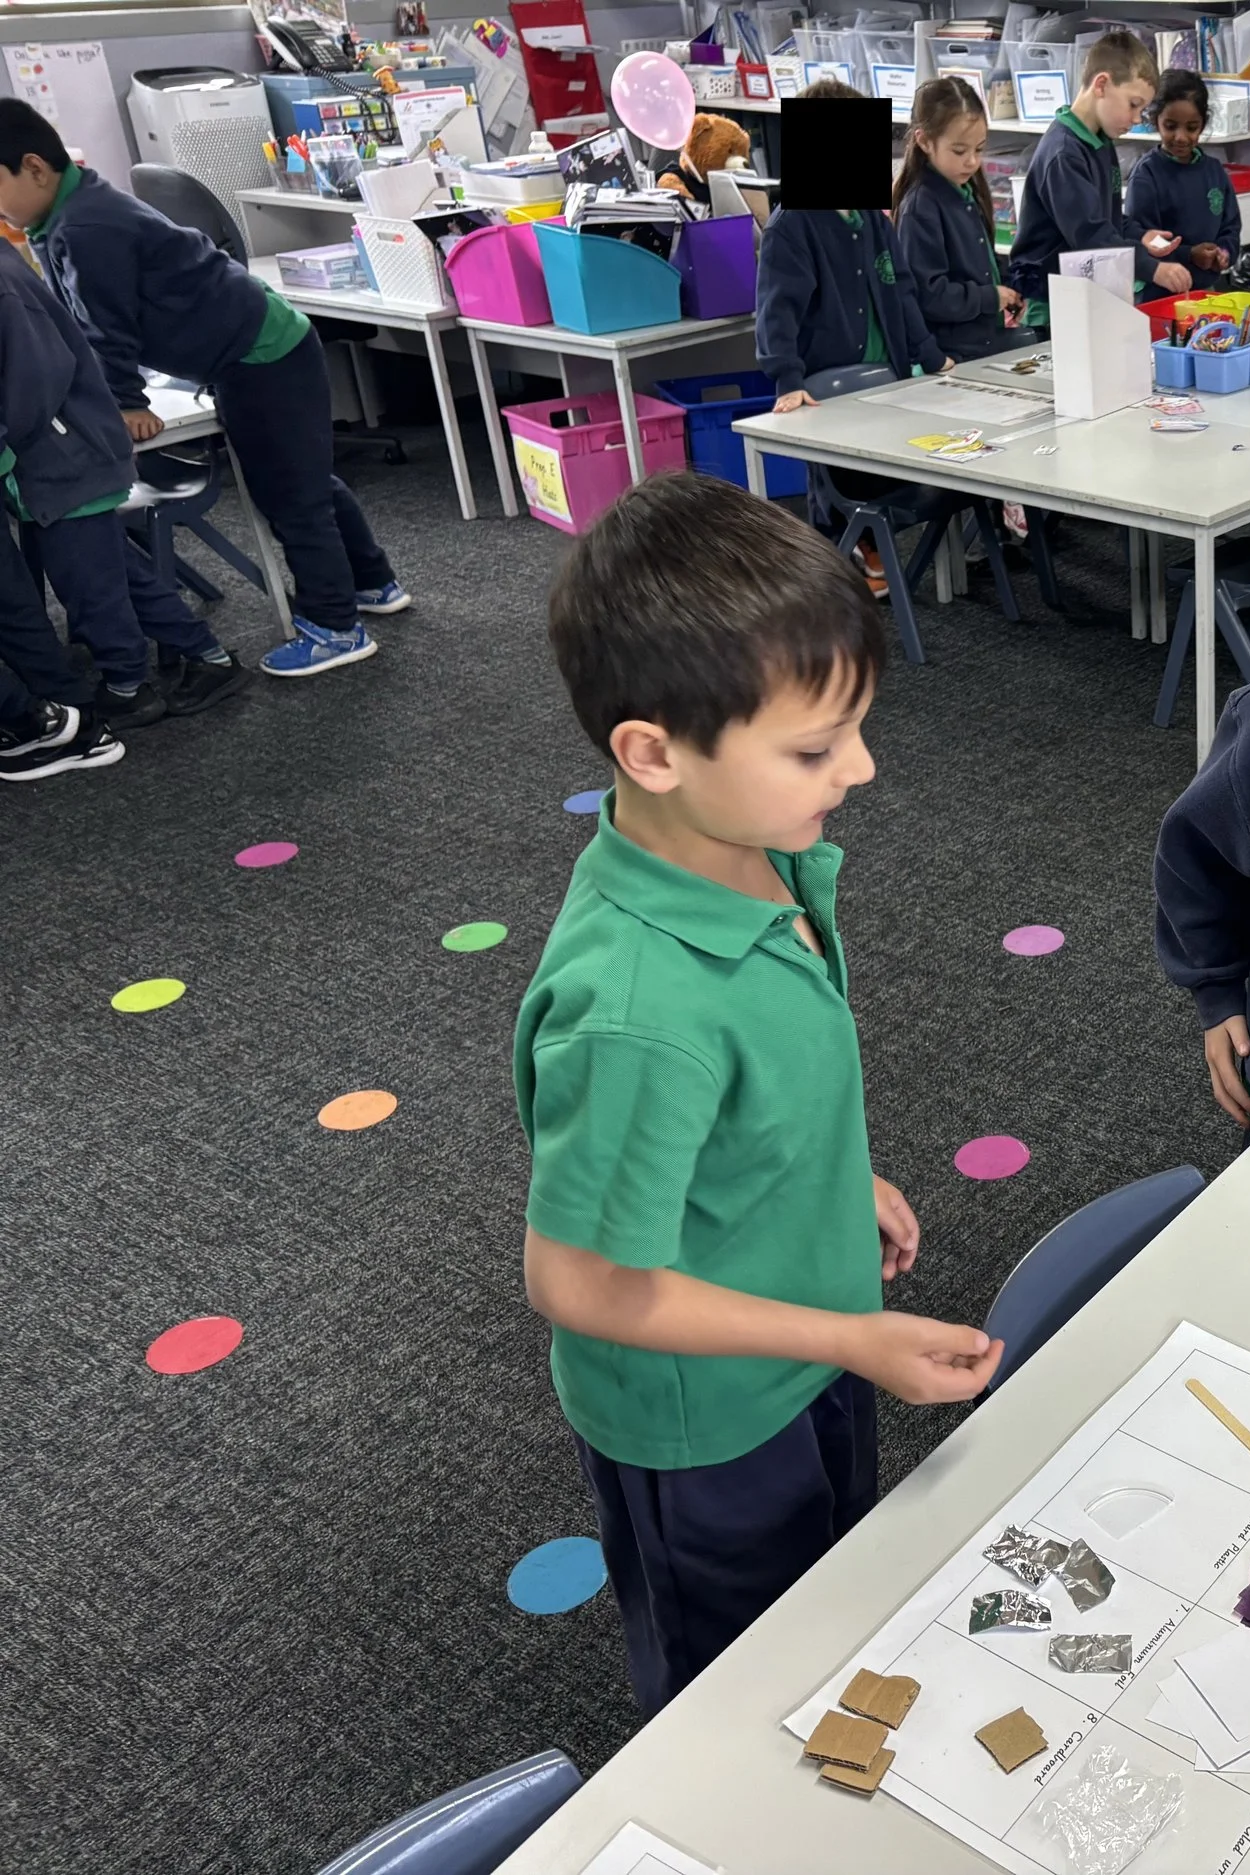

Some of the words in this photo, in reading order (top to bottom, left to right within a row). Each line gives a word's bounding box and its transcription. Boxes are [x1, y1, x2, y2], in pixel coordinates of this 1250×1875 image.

[1213, 1543, 1240, 1570] Plastic
[1175, 1603, 1191, 1613] 7.
[1133, 1617, 1176, 1665] Aluminum
[1082, 1712, 1098, 1724] 8.
[1033, 1731, 1084, 1787] Cardboard
